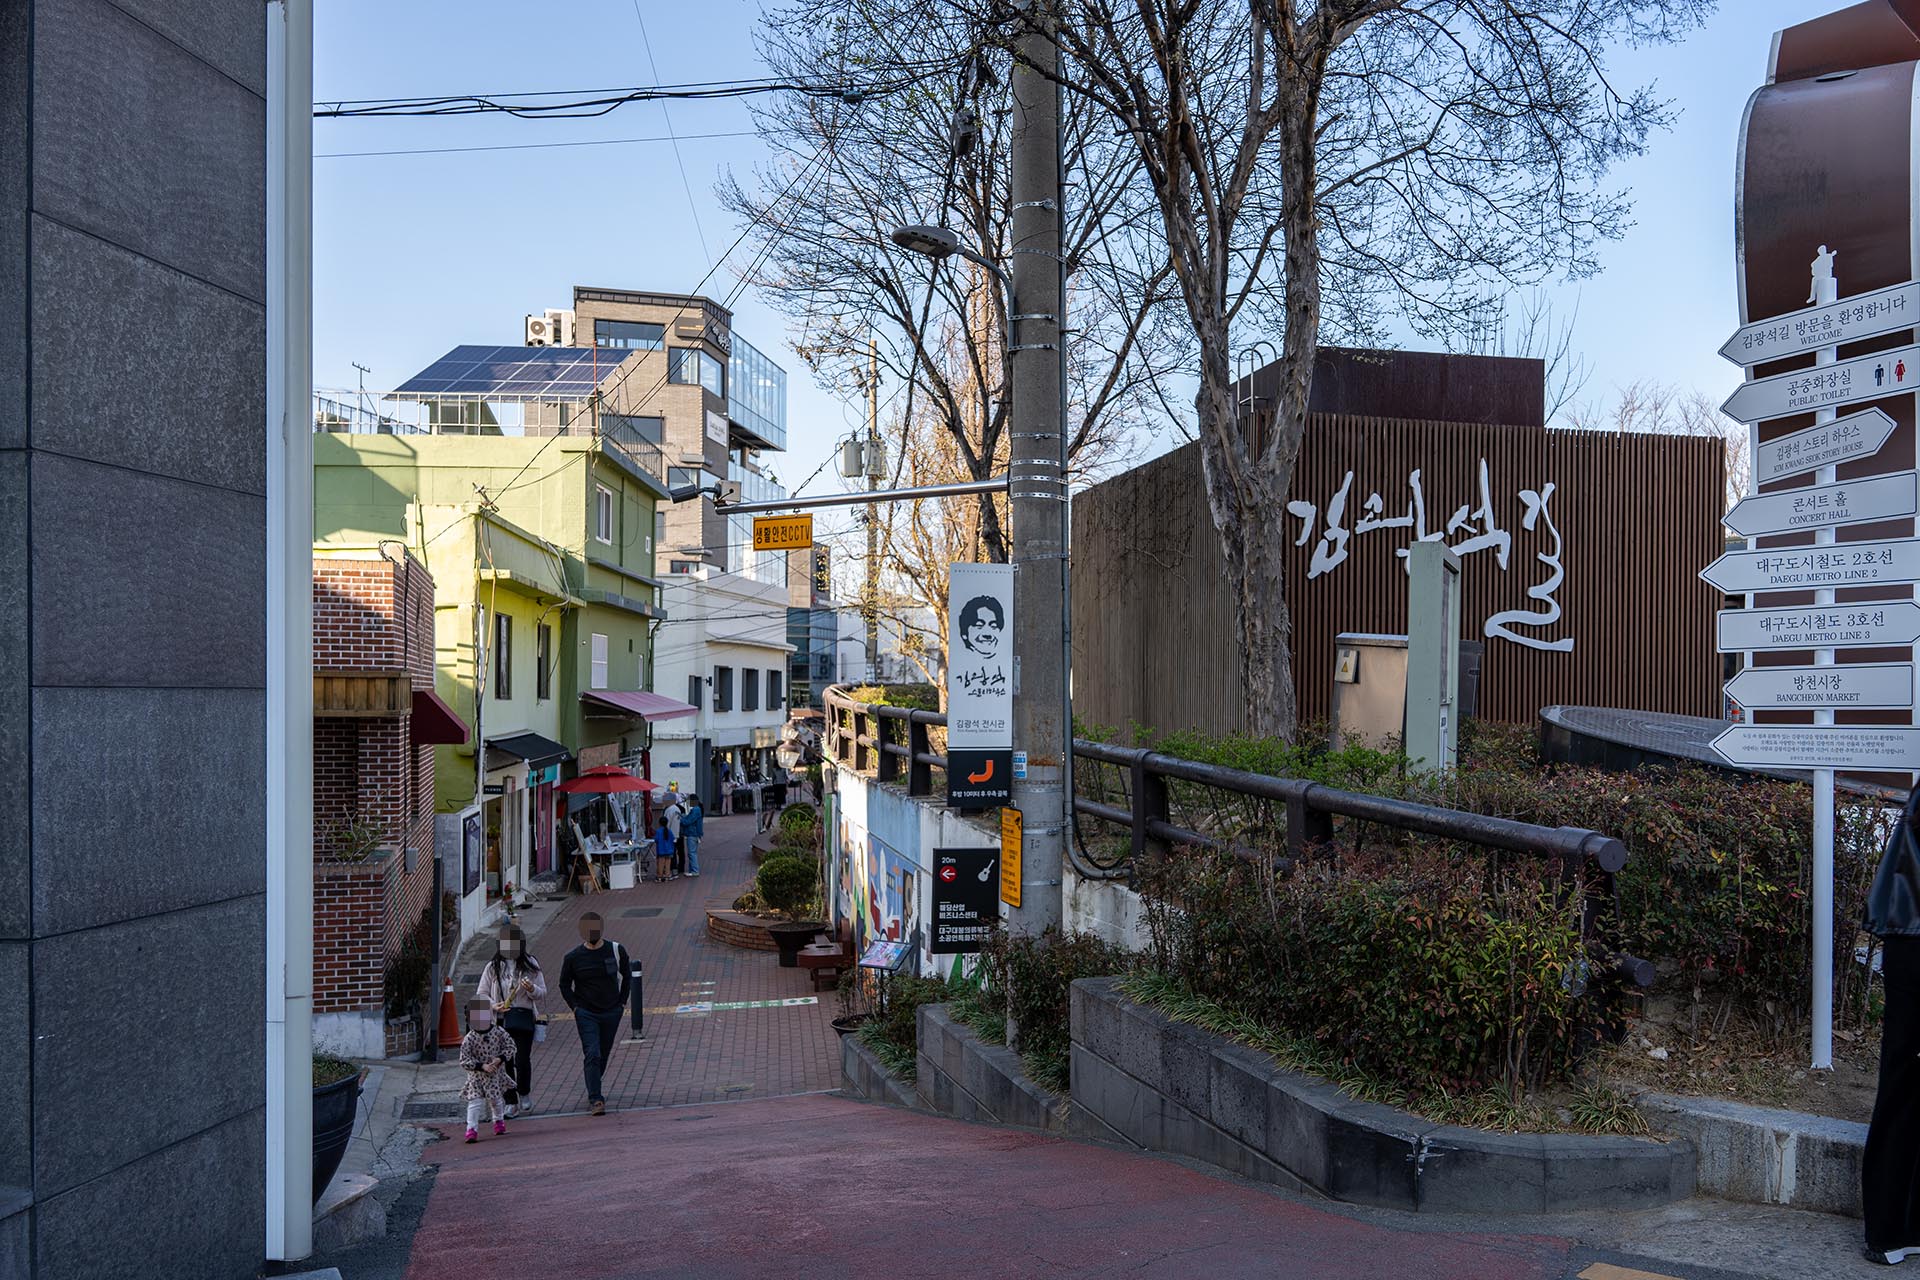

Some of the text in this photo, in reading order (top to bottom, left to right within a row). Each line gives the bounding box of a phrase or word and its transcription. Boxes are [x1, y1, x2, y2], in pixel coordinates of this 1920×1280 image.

[1742, 295, 1906, 350] 김광석길 방문을 환영합니다
[1800, 328, 1842, 346] WELCOME
[1787, 368, 1851, 397] 공중화장실
[1789, 387, 1851, 408] PUBLIC TOILET
[1776, 424, 1861, 461] 김광석 스토리 하우스
[1773, 441, 1864, 474] KIM KWANG SEOK STORY HOUSE
[1793, 490, 1847, 513] 콘서트 홀
[1789, 510, 1851, 525] CONCERT HALL
[756, 525, 810, 544] 생활안전CCTV
[1756, 549, 1893, 573] 대구도시철도 2호선
[1770, 569, 1878, 584] DAEGU METRO LINE 2
[1760, 611, 1885, 632] 대구도시철도 3호선
[1772, 631, 1870, 643] DAEGU METRO LINE 3
[1793, 674, 1842, 691] 방천시장
[1776, 692, 1860, 702] BANGCHEON MARKET
[956, 719, 1005, 729] 김광석 전시관
